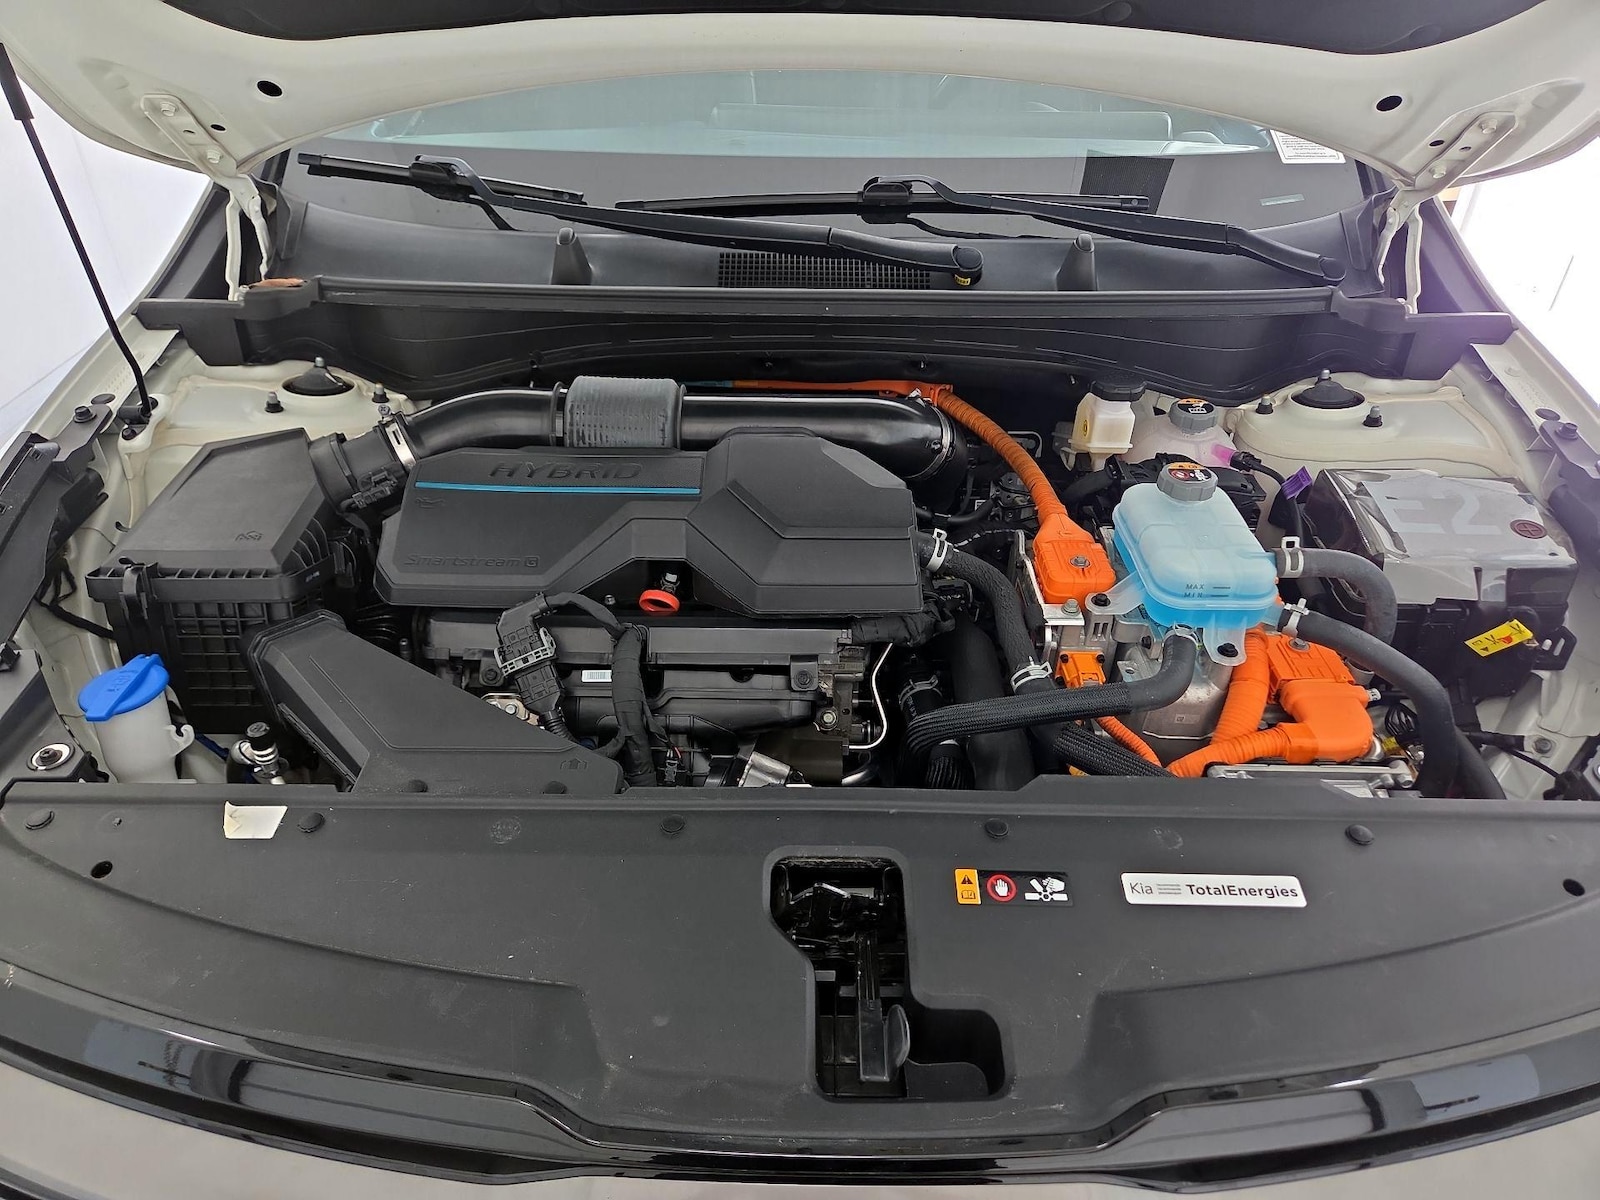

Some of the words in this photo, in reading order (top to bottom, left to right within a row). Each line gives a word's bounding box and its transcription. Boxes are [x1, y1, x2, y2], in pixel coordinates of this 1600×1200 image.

[489, 461, 643, 480] HYBRID
[404, 554, 521, 568] Smartstream
[1129, 882, 1154, 895] Kia
[1185, 883, 1299, 899] TotalEnergies
